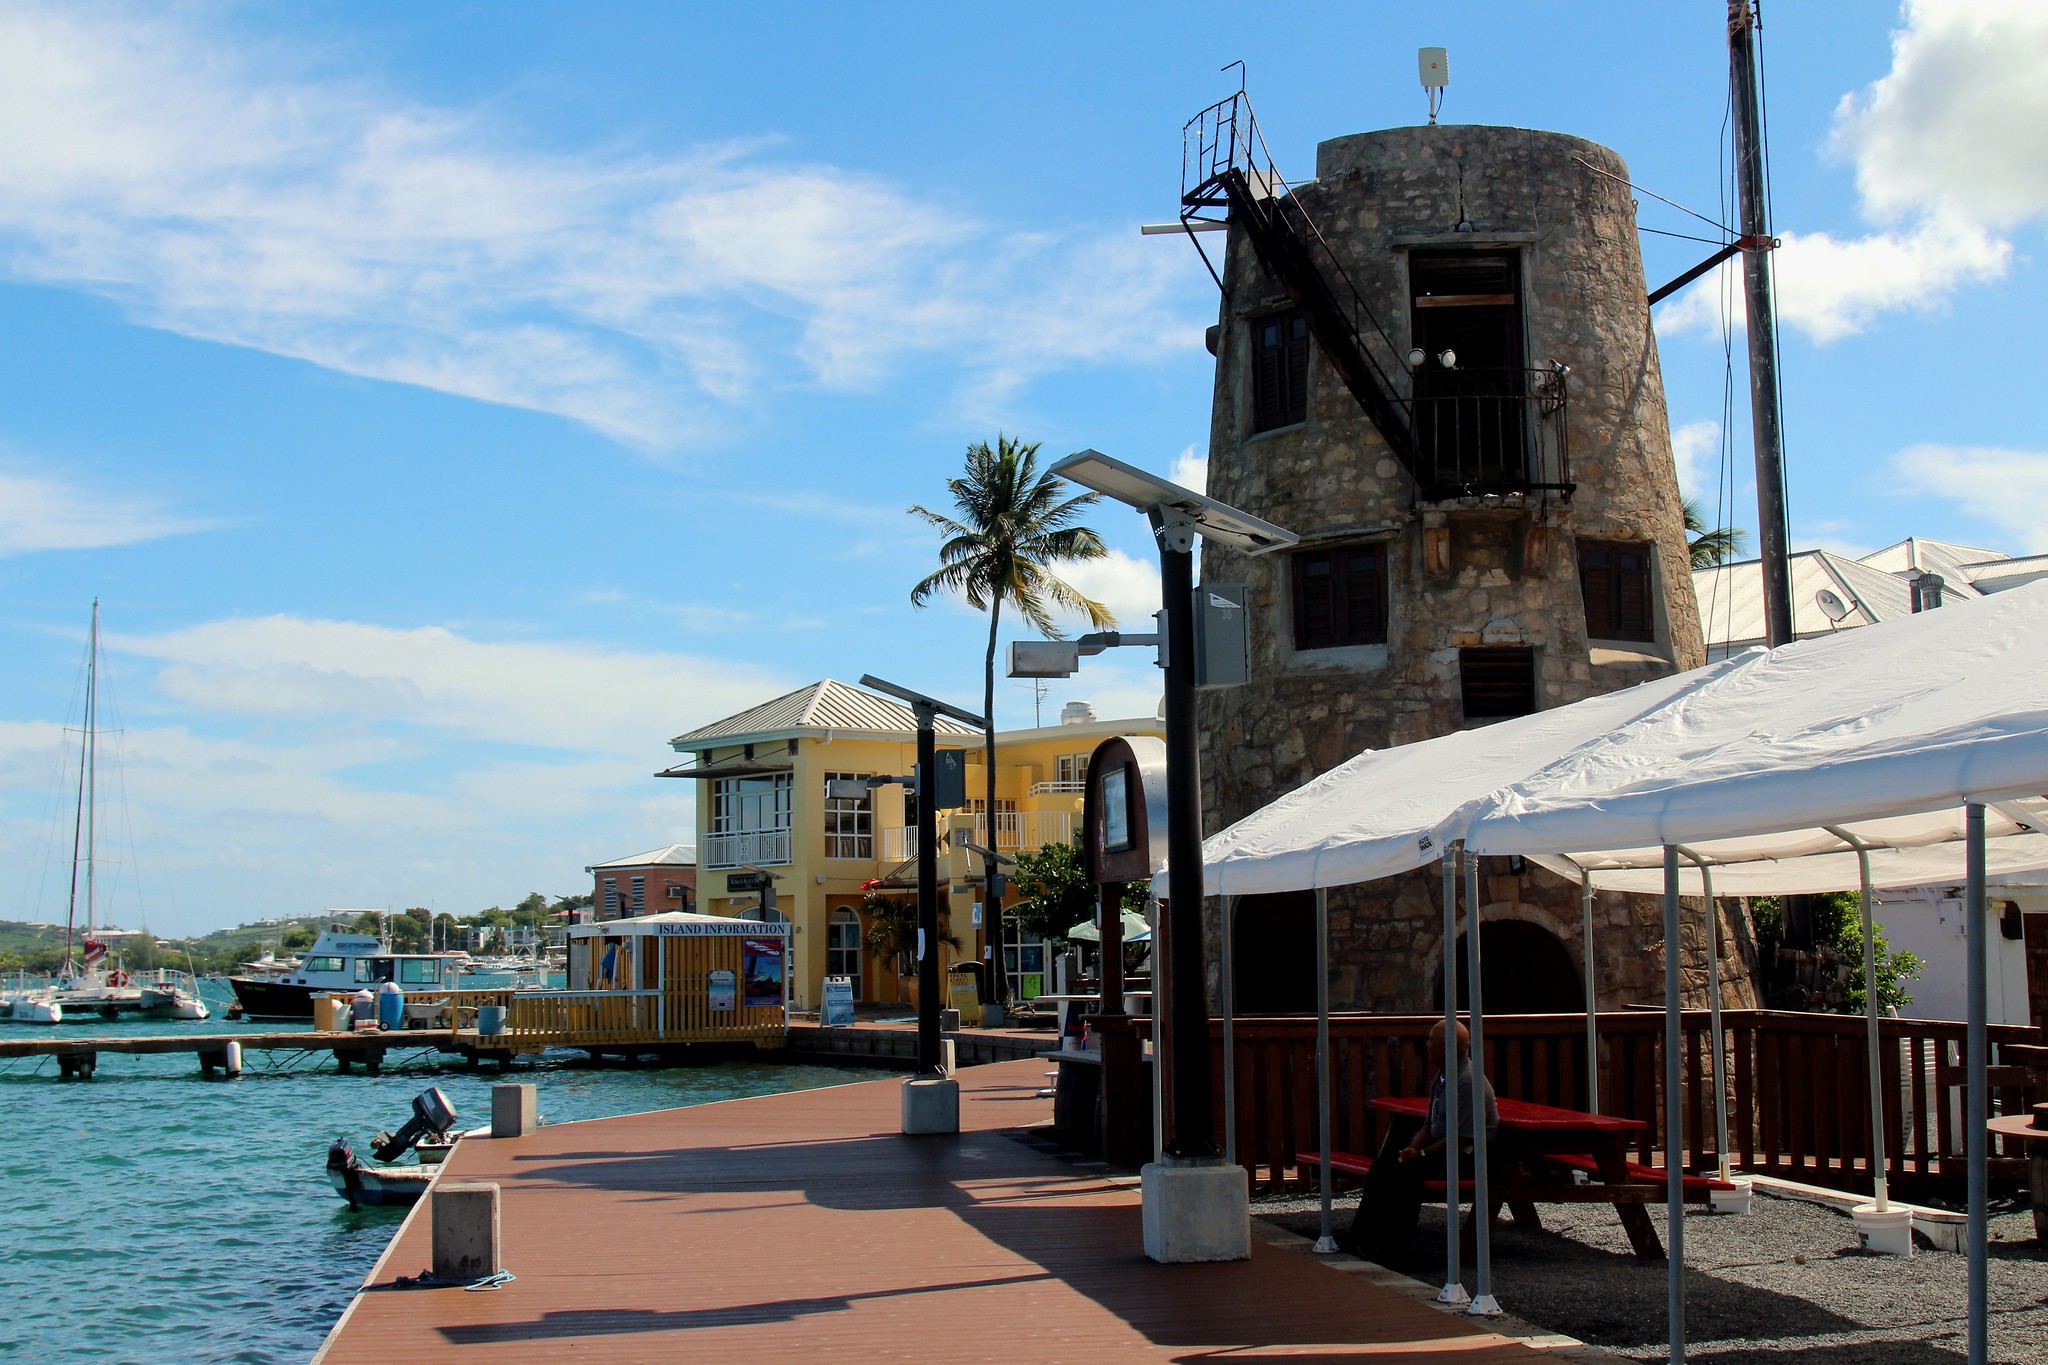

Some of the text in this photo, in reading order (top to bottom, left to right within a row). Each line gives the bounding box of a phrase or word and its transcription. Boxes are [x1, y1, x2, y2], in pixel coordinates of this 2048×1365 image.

[1221, 609, 1232, 620] 36
[659, 924, 785, 935] ISLAND INFORMATION
